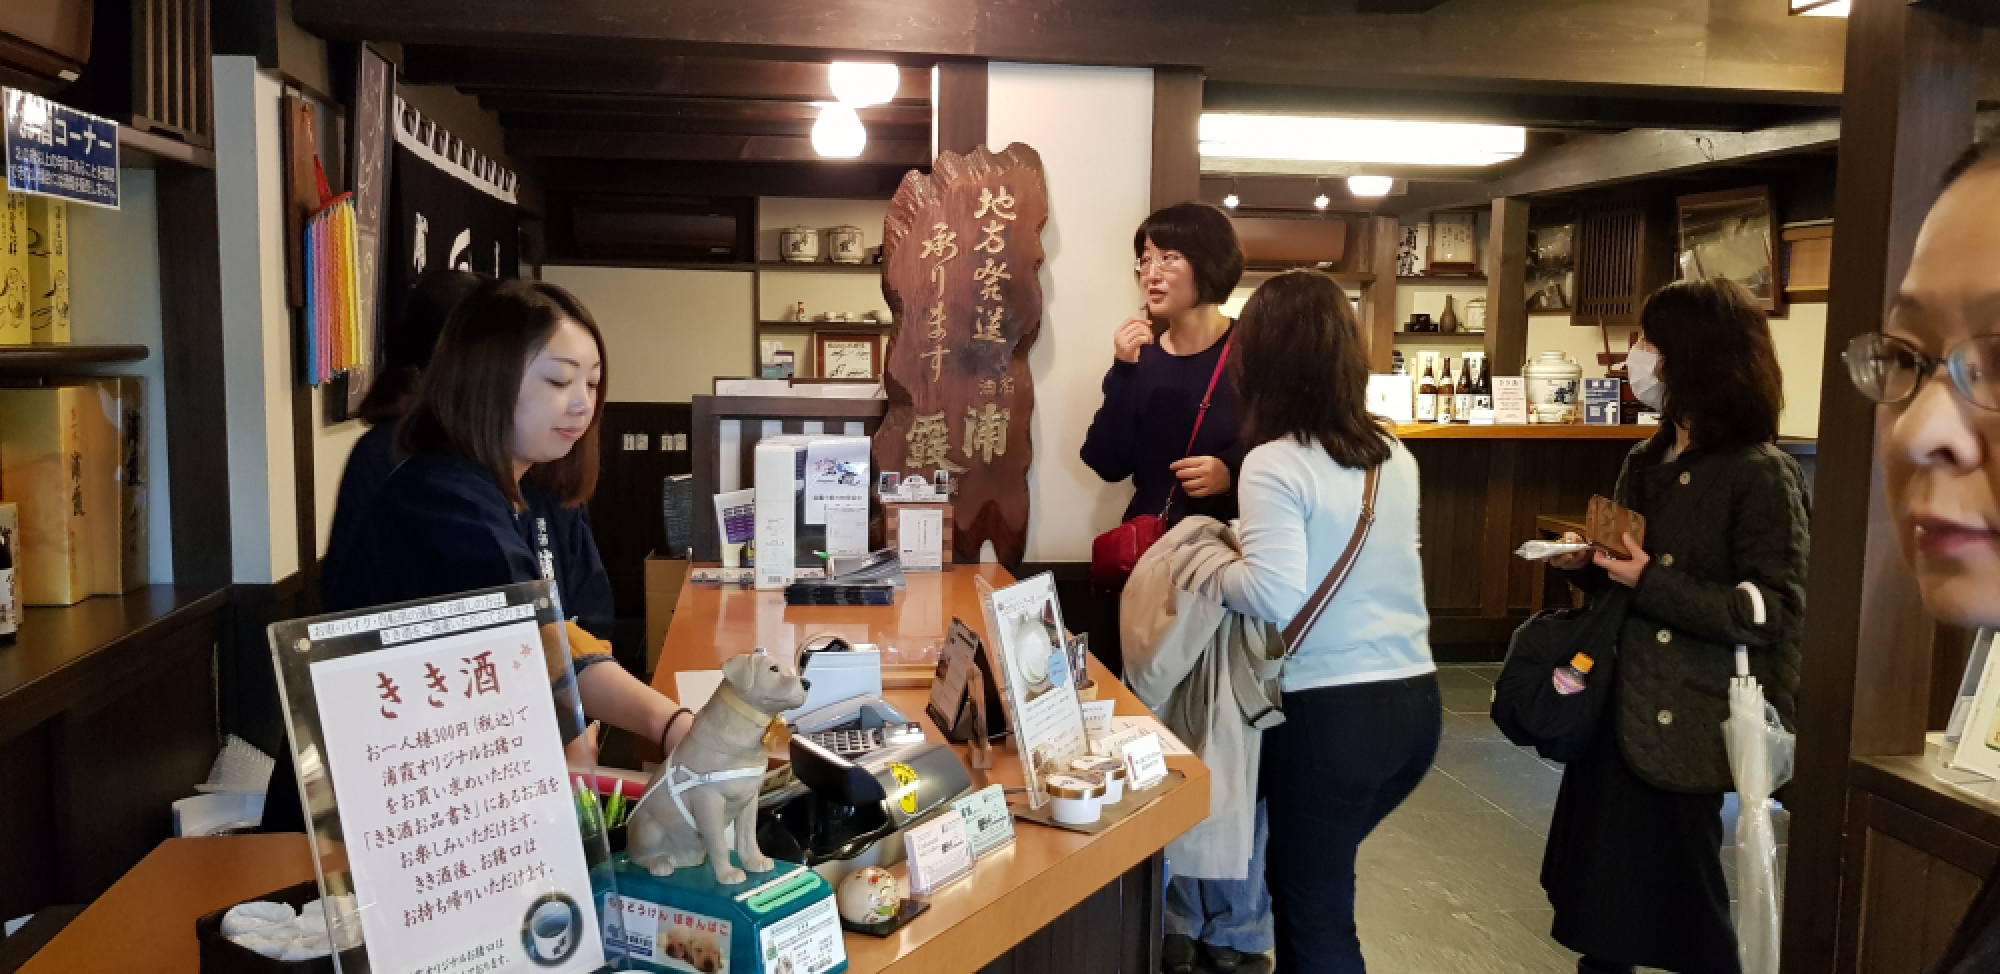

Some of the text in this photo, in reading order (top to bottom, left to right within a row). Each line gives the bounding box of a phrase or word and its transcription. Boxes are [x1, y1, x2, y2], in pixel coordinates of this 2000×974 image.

[971, 185, 1017, 343] 地方発送
[920, 222, 959, 383] 承ります
[376, 650, 502, 720] きき酒
[381, 734, 524, 788] 浦霞オリジナルお猪口
[384, 759, 532, 815] をお買い求めいただくと
[364, 776, 560, 852] 「きき酒お品書き」にあるお酒を
[399, 812, 538, 869] お楽しみいただけます。
[403, 860, 555, 928] お持ち帰りいただけます。
[414, 839, 537, 895] きき酒後、お猪口は
